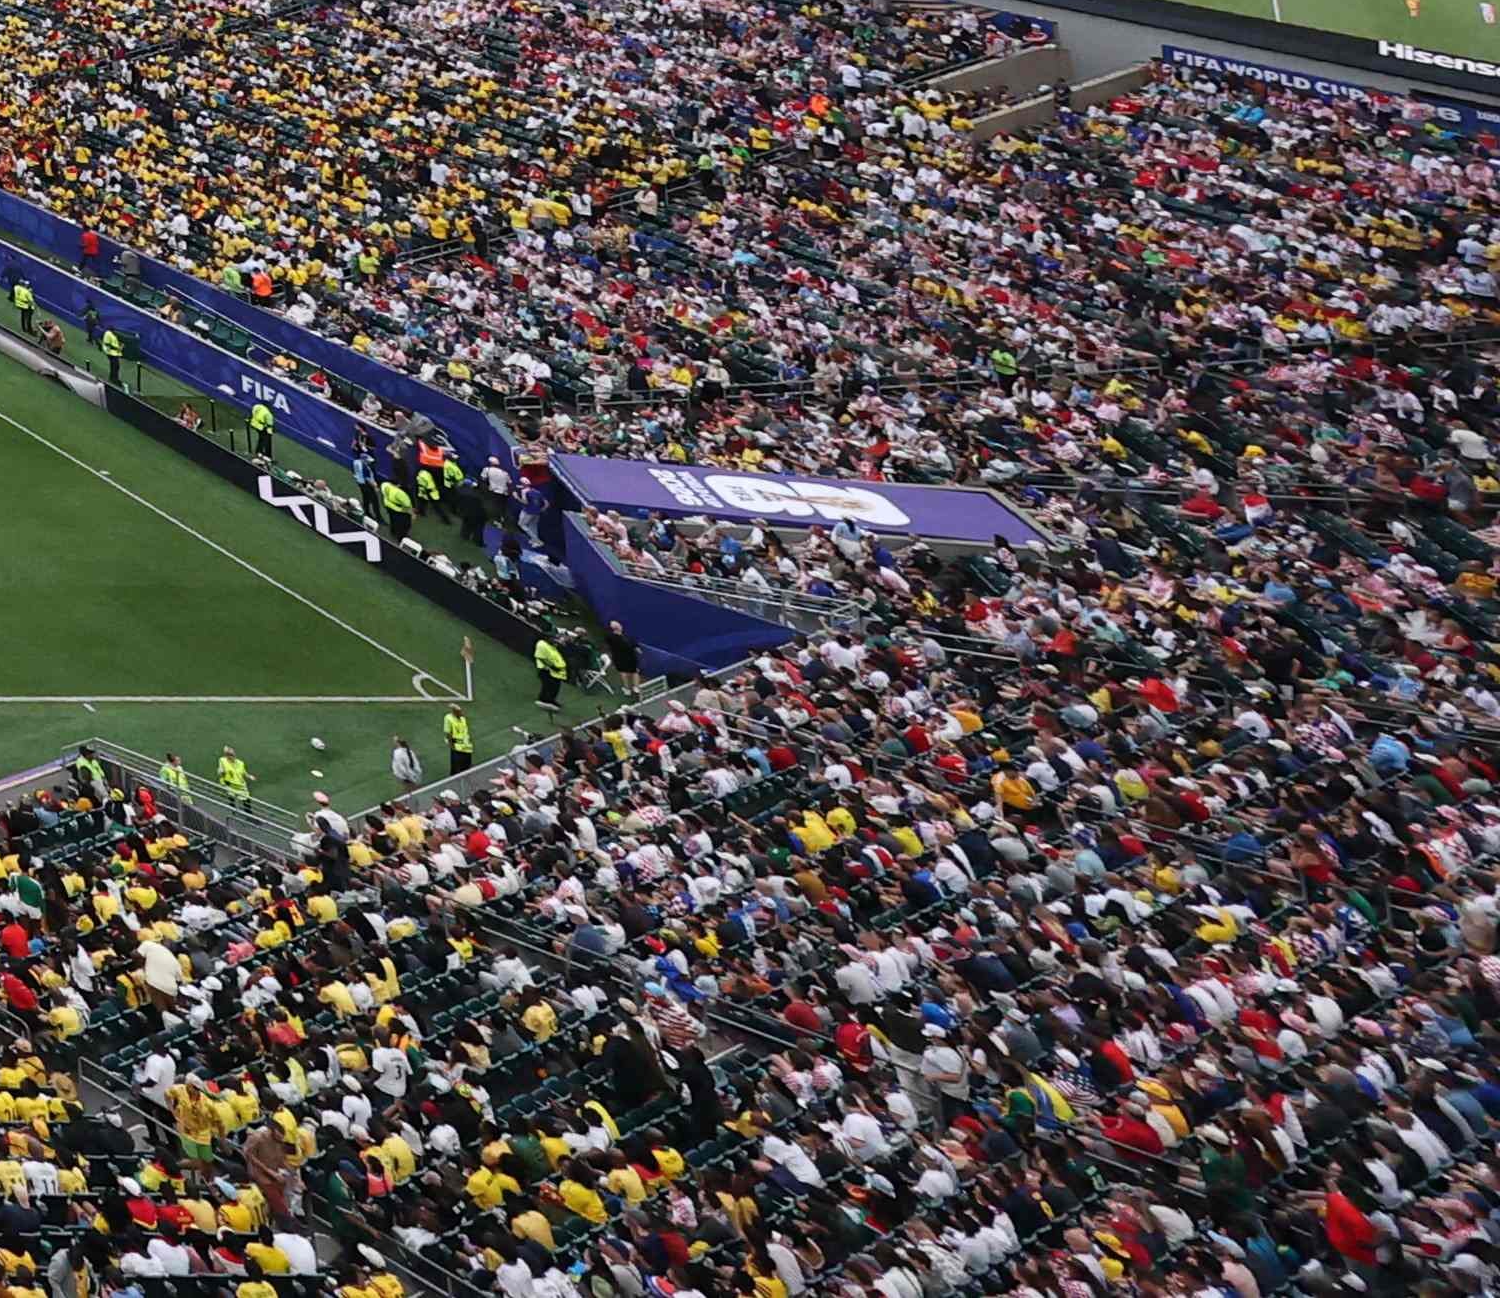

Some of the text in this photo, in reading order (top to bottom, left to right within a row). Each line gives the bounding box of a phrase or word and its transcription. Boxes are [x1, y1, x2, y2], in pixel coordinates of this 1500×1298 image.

[1172, 49, 1222, 74] FIFA
[1313, 79, 1366, 103] CUP
[240, 374, 291, 415] FIFA
